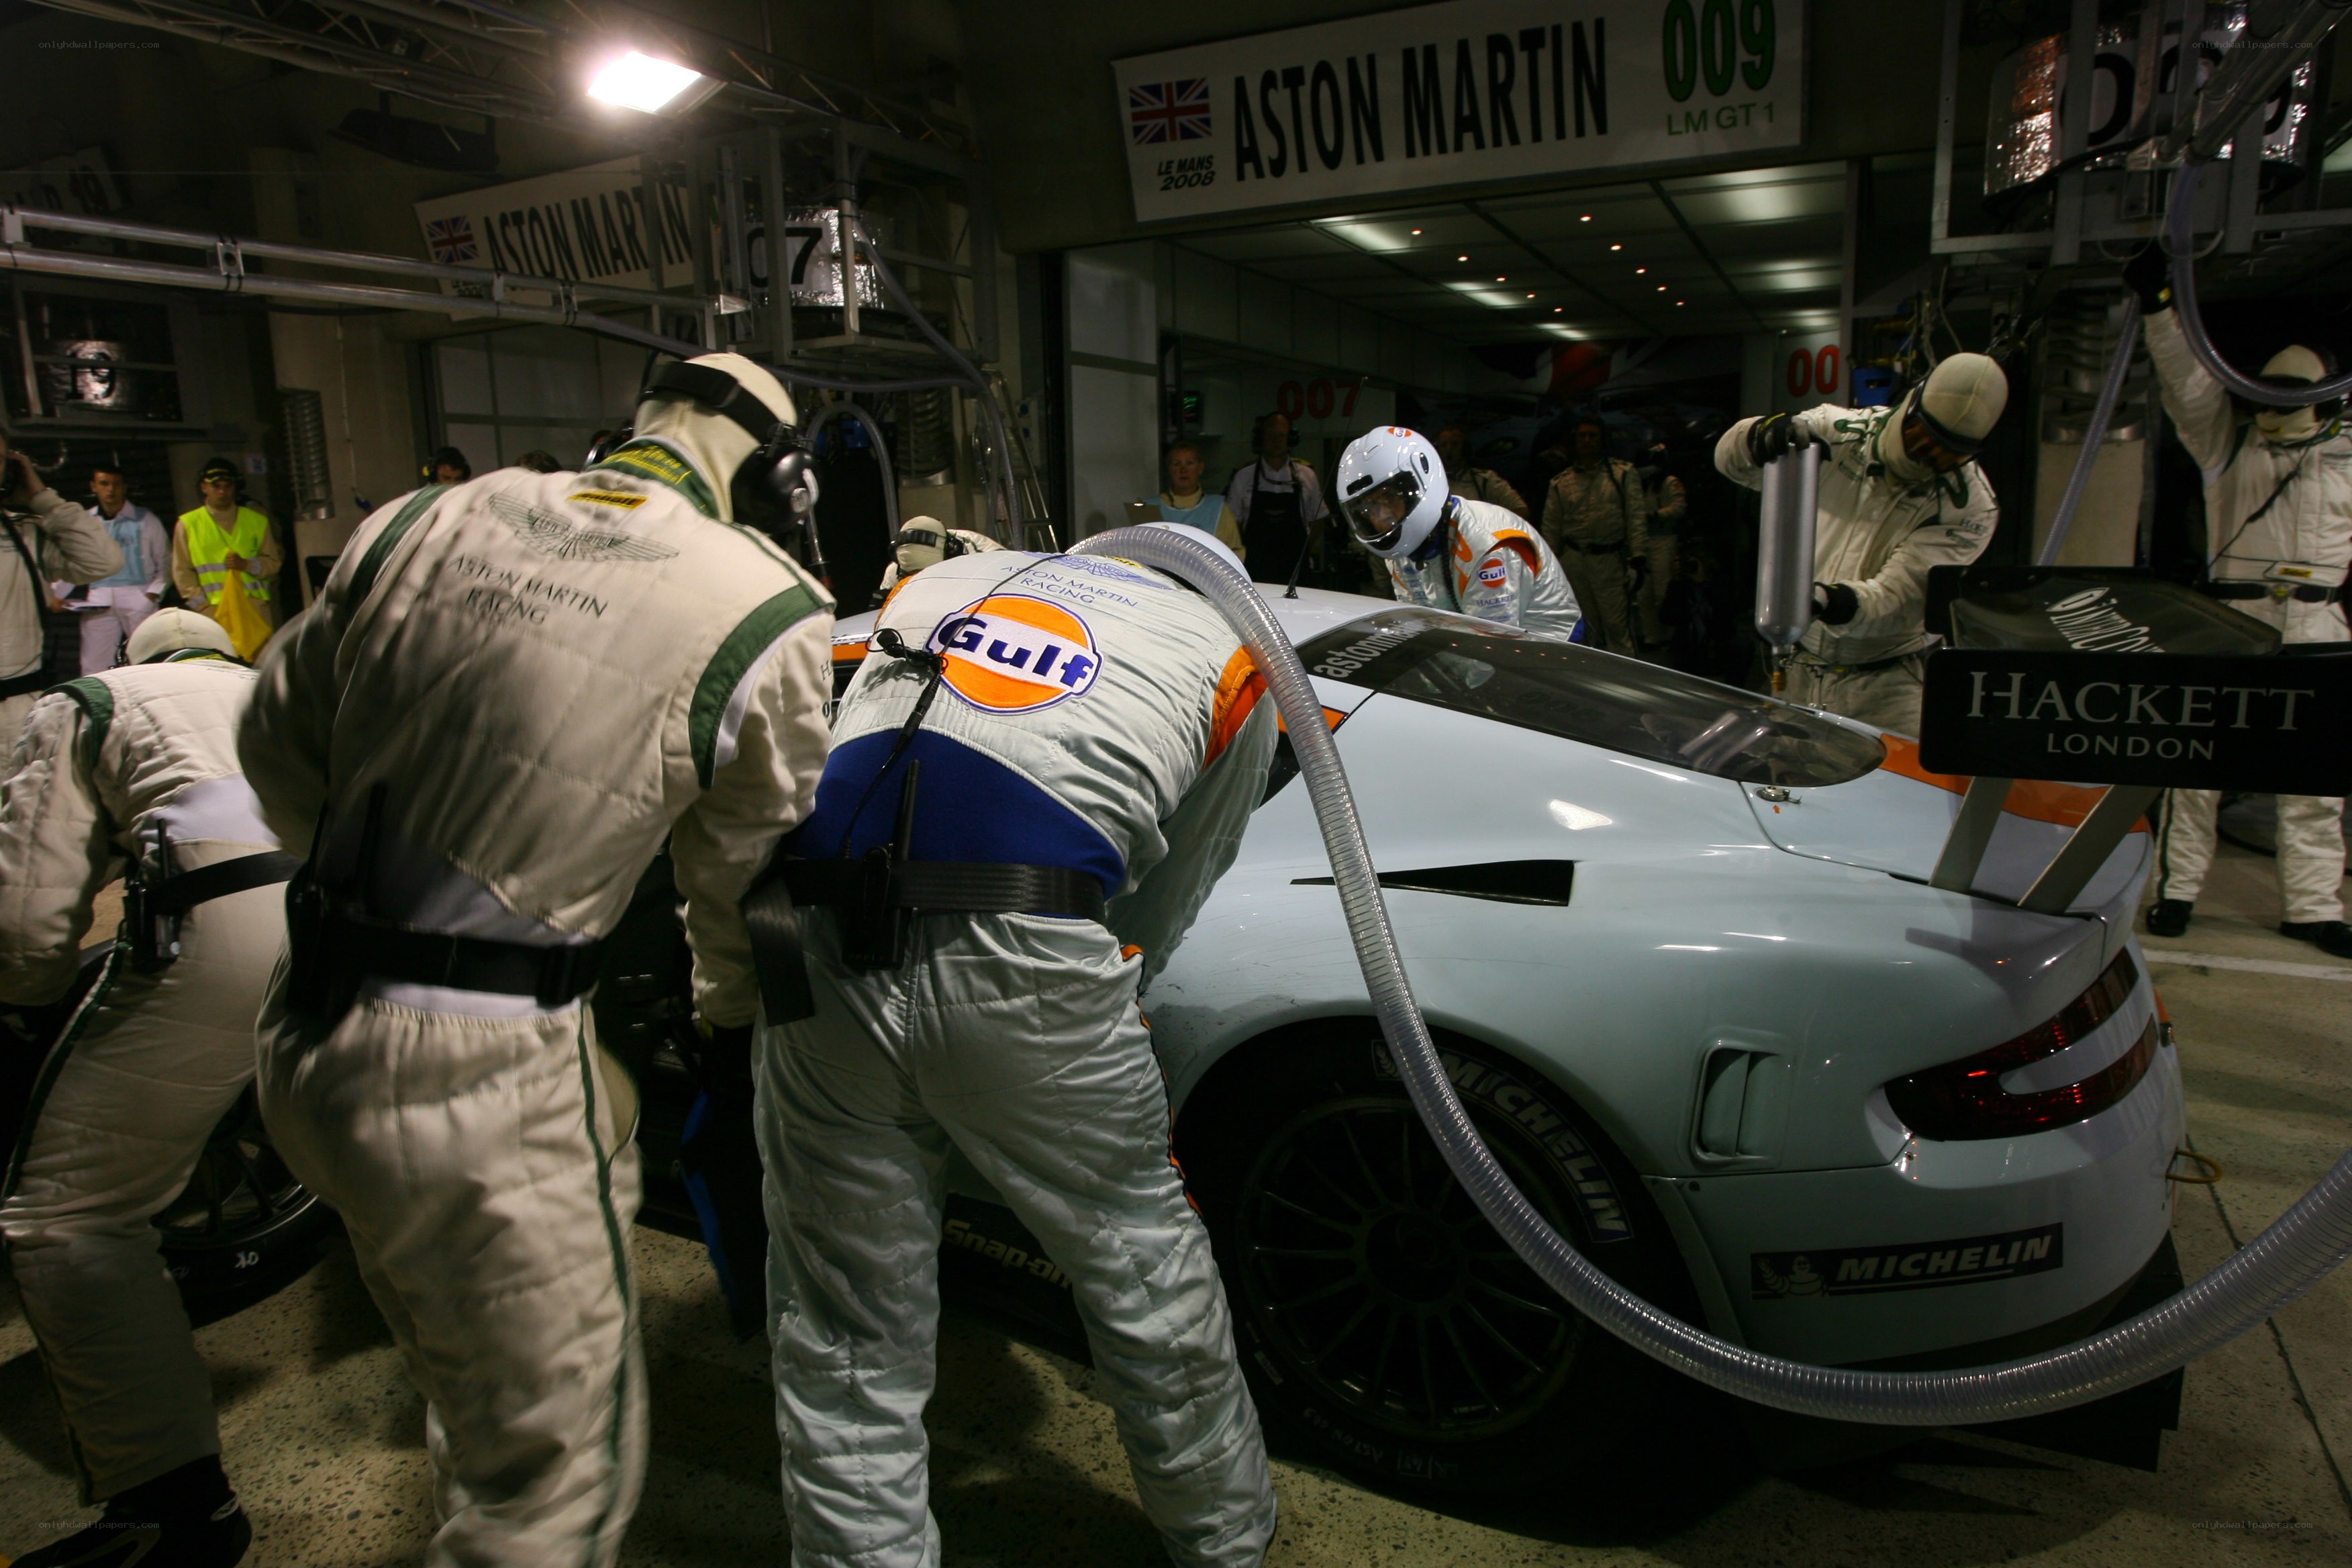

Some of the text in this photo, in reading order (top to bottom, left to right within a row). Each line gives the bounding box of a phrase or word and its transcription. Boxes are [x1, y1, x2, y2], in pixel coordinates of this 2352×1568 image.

[1664, 0, 1775, 101] 009
[1234, 17, 1608, 181] ASTON MARTIN
[1157, 154, 1214, 176] LE MANS
[1160, 170, 1216, 191] 2008
[484, 202, 581, 281] ASTON
[1277, 378, 1359, 420] 007
[448, 553, 609, 619] ASTON MARTIN
[1002, 565, 1065, 583] ASTON
[1067, 579, 1138, 607] MARTIN
[1020, 577, 1095, 604] RACING
[938, 617, 1093, 687] Gulf
[1966, 671, 2316, 731] HACKETT
[2047, 732, 2214, 761] LONDON
[1440, 1052, 1629, 1233] MICHELIN
[1836, 1234, 2052, 1282] MICHELIN
